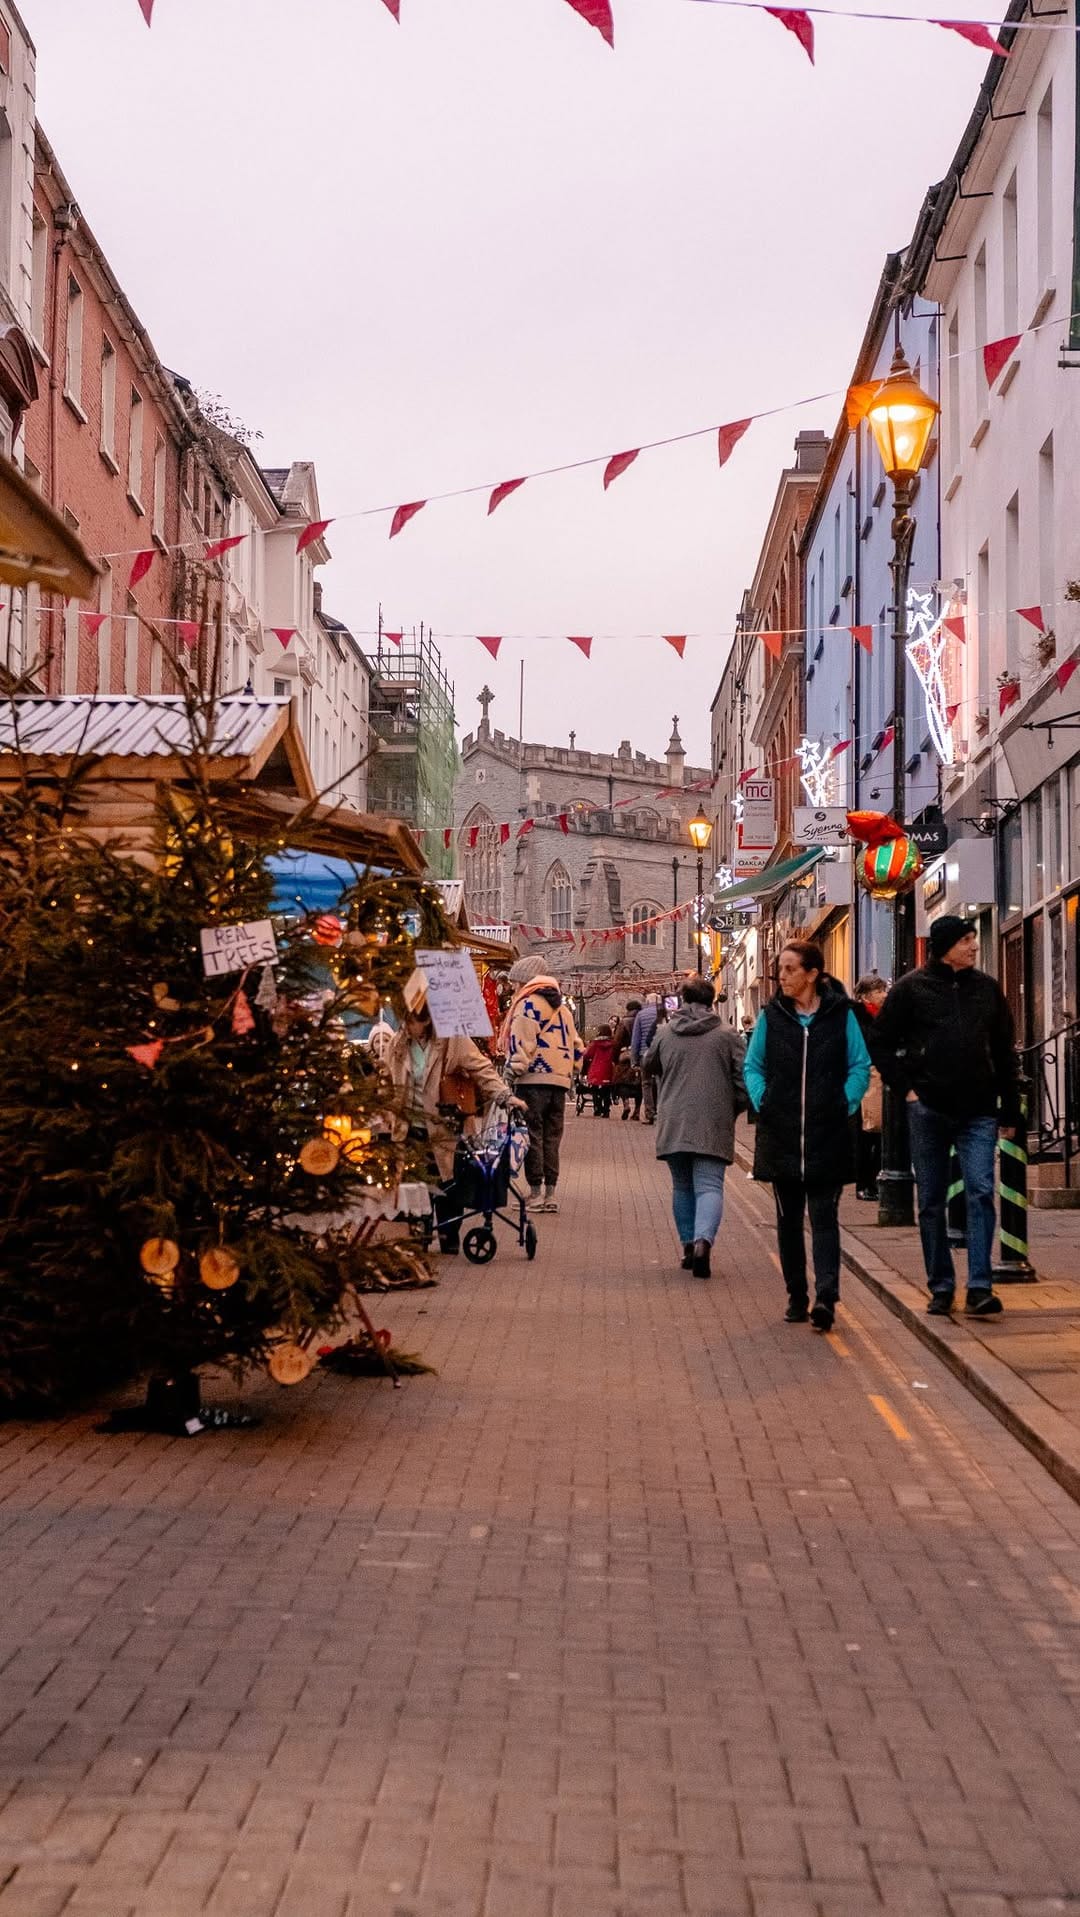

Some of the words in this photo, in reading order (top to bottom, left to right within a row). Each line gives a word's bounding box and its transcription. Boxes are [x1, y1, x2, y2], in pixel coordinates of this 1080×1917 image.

[745, 781, 772, 798] mci
[797, 823, 843, 840] Syenna
[214, 926, 256, 946] REAL
[203, 940, 278, 971] TREES
